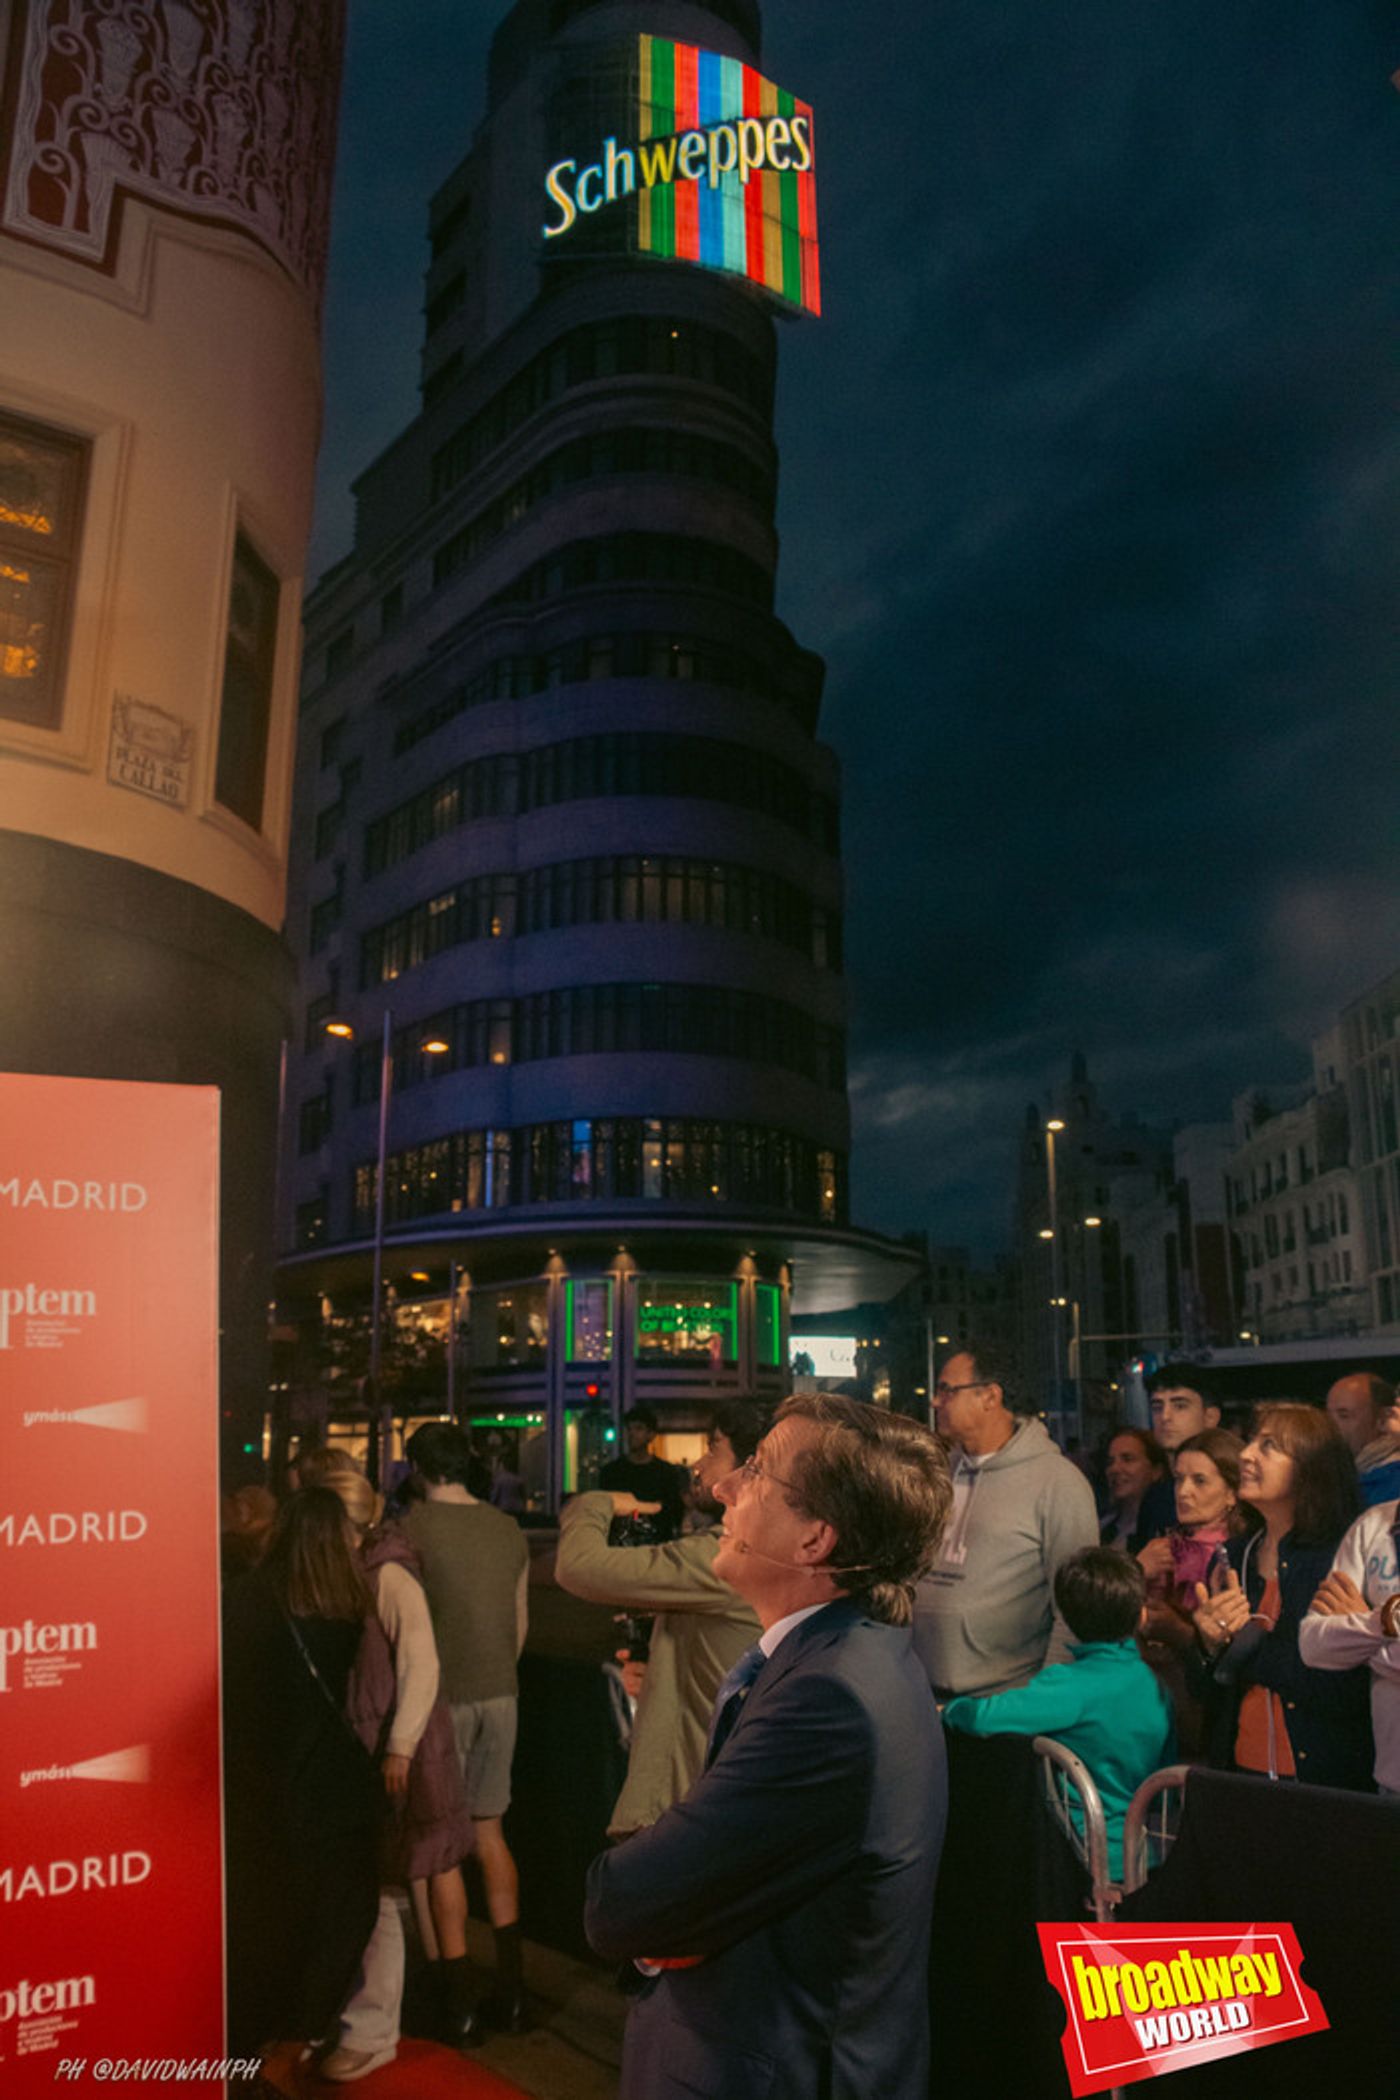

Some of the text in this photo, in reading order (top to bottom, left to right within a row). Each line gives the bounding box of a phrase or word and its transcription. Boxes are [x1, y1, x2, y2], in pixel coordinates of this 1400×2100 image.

[543, 115, 811, 239] Schweppes
[119, 763, 178, 800] CALLAO
[0, 1178, 147, 1211] MADRID
